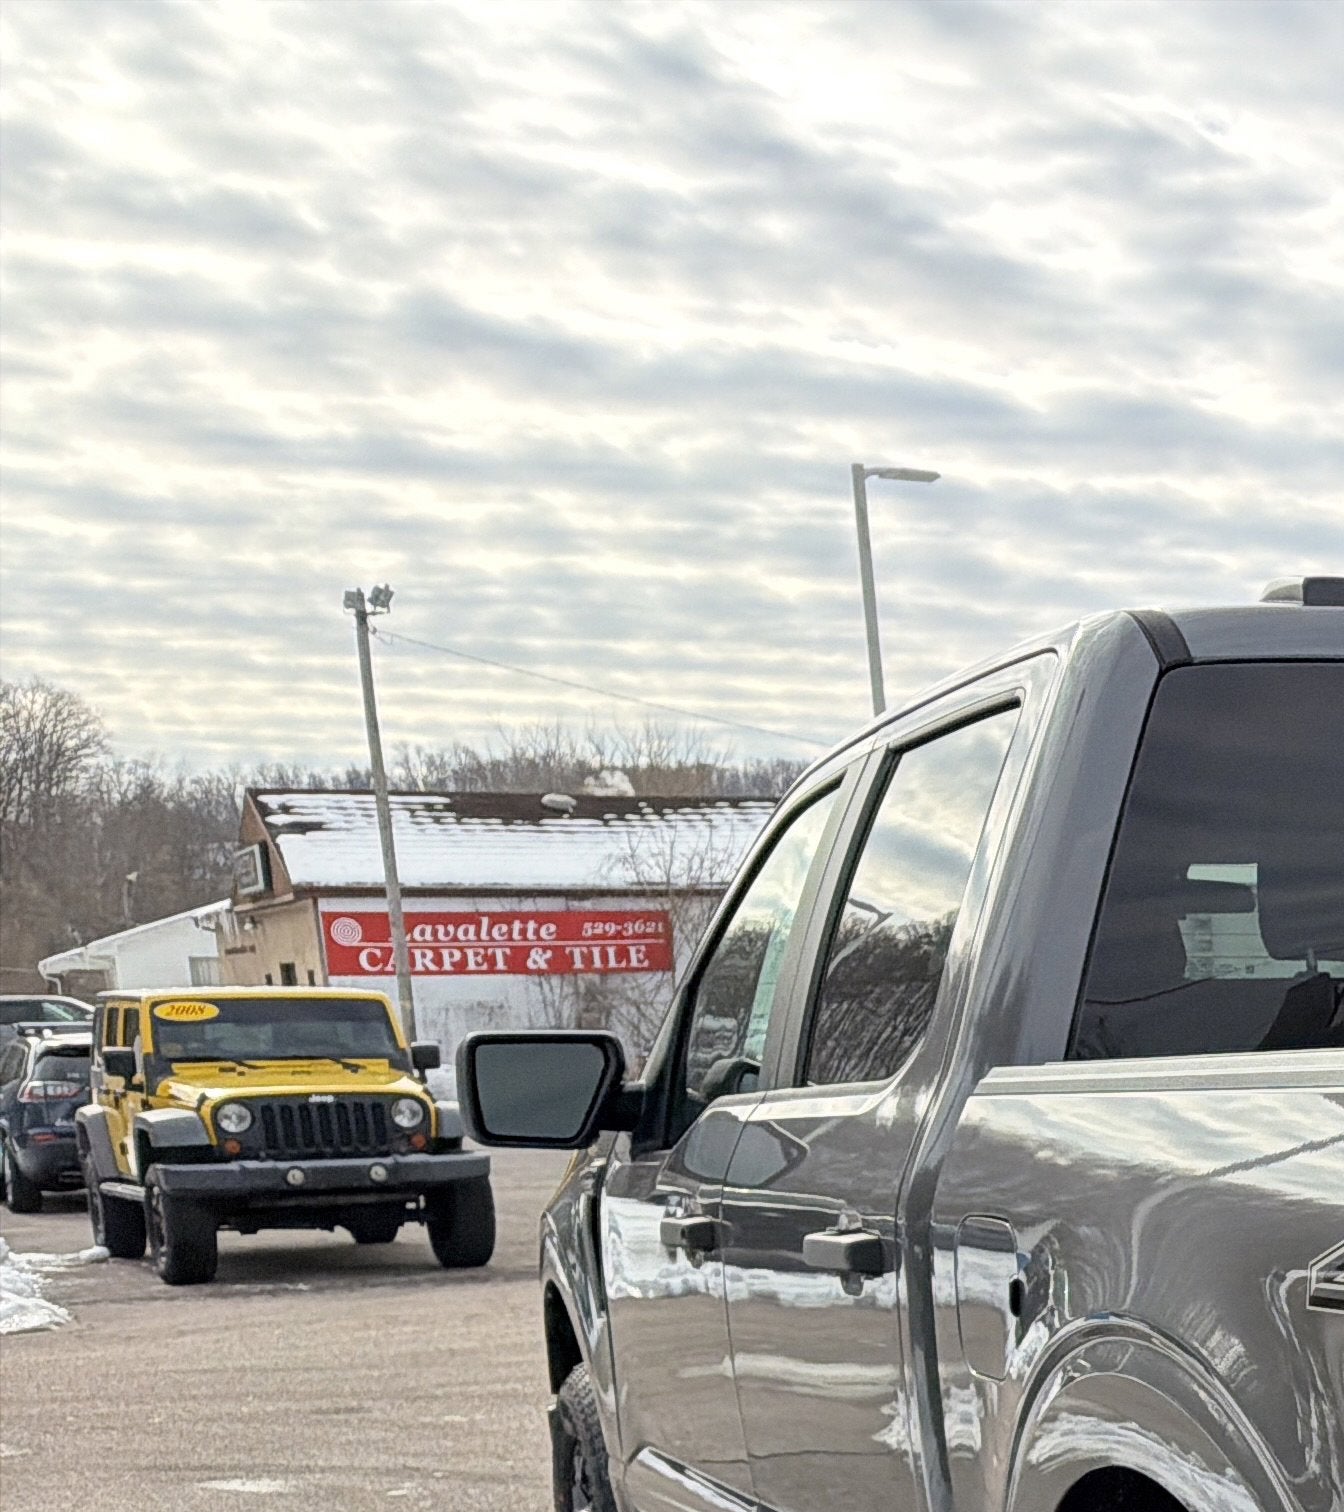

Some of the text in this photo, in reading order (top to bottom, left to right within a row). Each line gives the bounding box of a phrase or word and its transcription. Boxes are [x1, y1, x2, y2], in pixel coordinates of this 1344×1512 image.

[388, 916, 664, 942] avalette 529-3621
[526, 947, 553, 970] &
[565, 944, 650, 969] TILE
